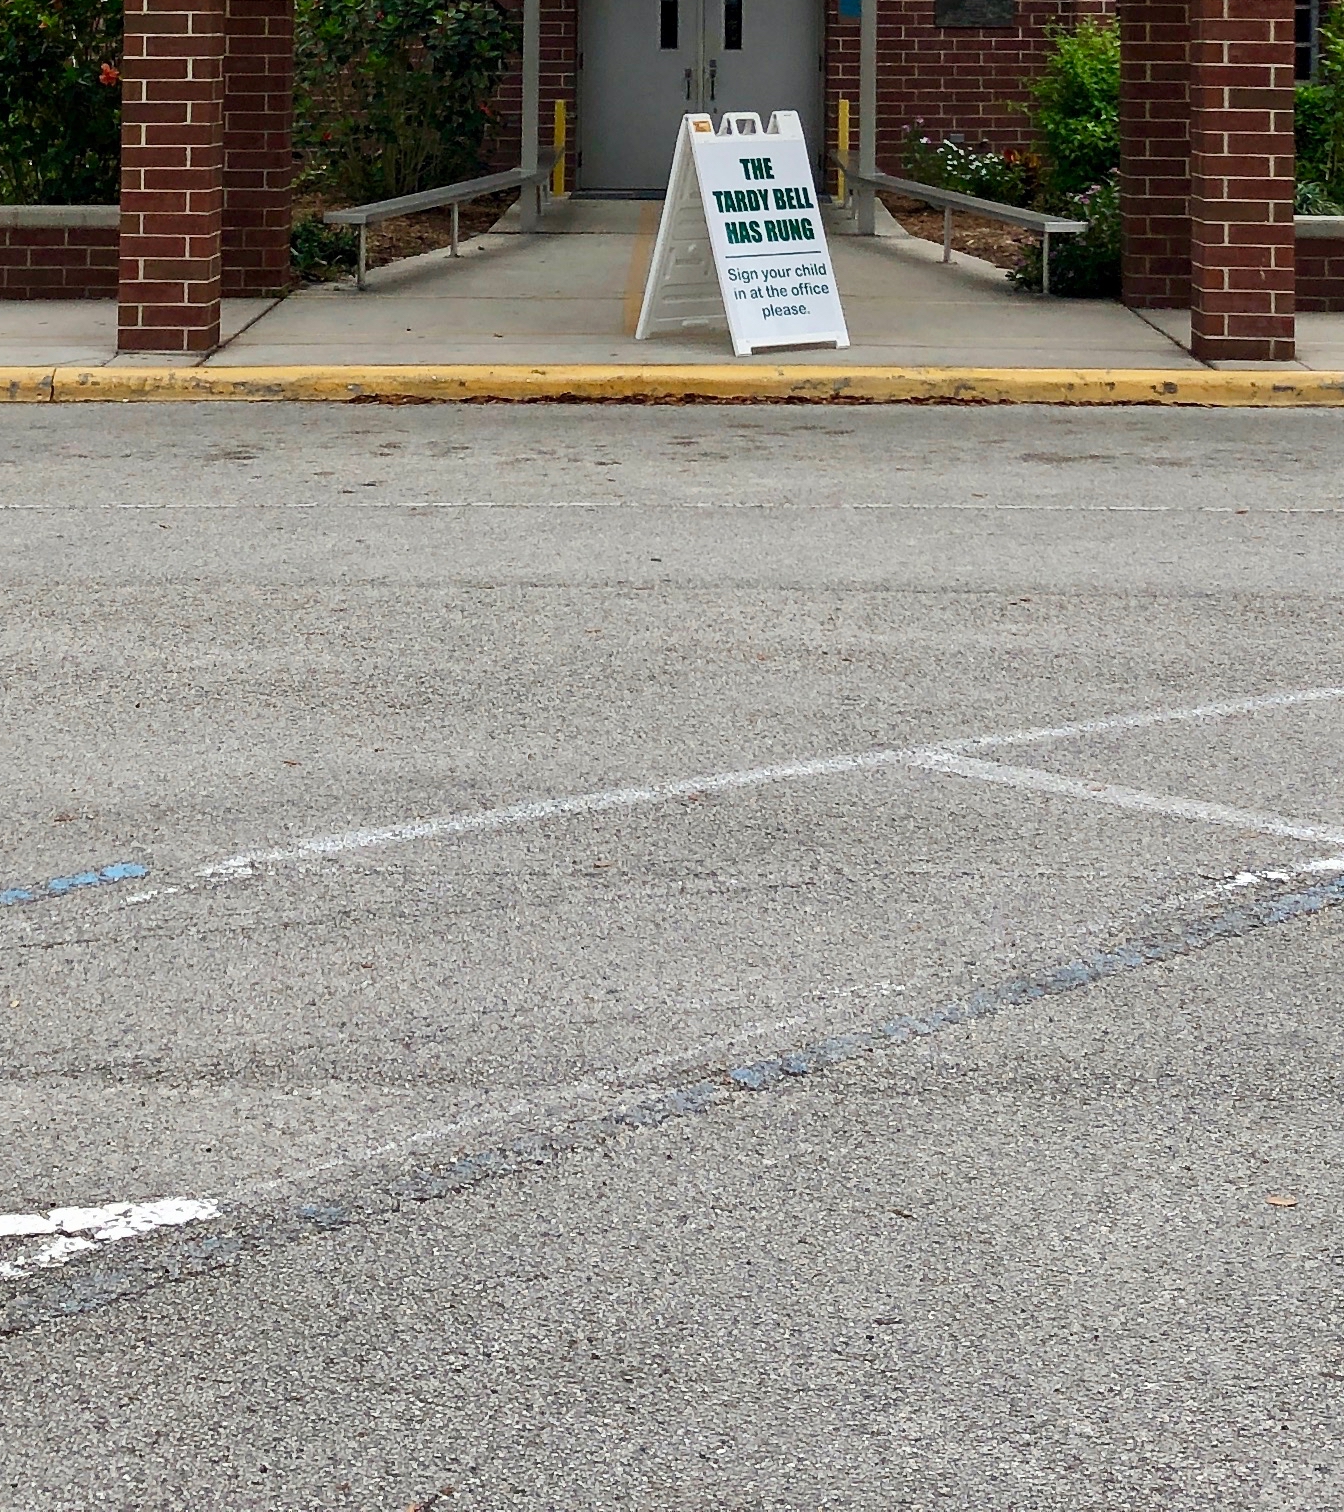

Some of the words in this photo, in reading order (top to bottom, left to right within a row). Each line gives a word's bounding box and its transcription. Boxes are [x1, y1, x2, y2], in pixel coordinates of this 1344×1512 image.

[740, 158, 775, 180] THE
[713, 189, 769, 213] TARDY
[773, 187, 814, 210] BELL
[725, 220, 763, 244] HAS
[764, 218, 815, 242] RUNG
[728, 267, 758, 283] Sign
[762, 265, 792, 281] your
[795, 263, 827, 278] child
[734, 288, 746, 300] in
[750, 286, 764, 299] at
[766, 284, 788, 298] the
[791, 283, 829, 297] office
[762, 302, 811, 320] please.
